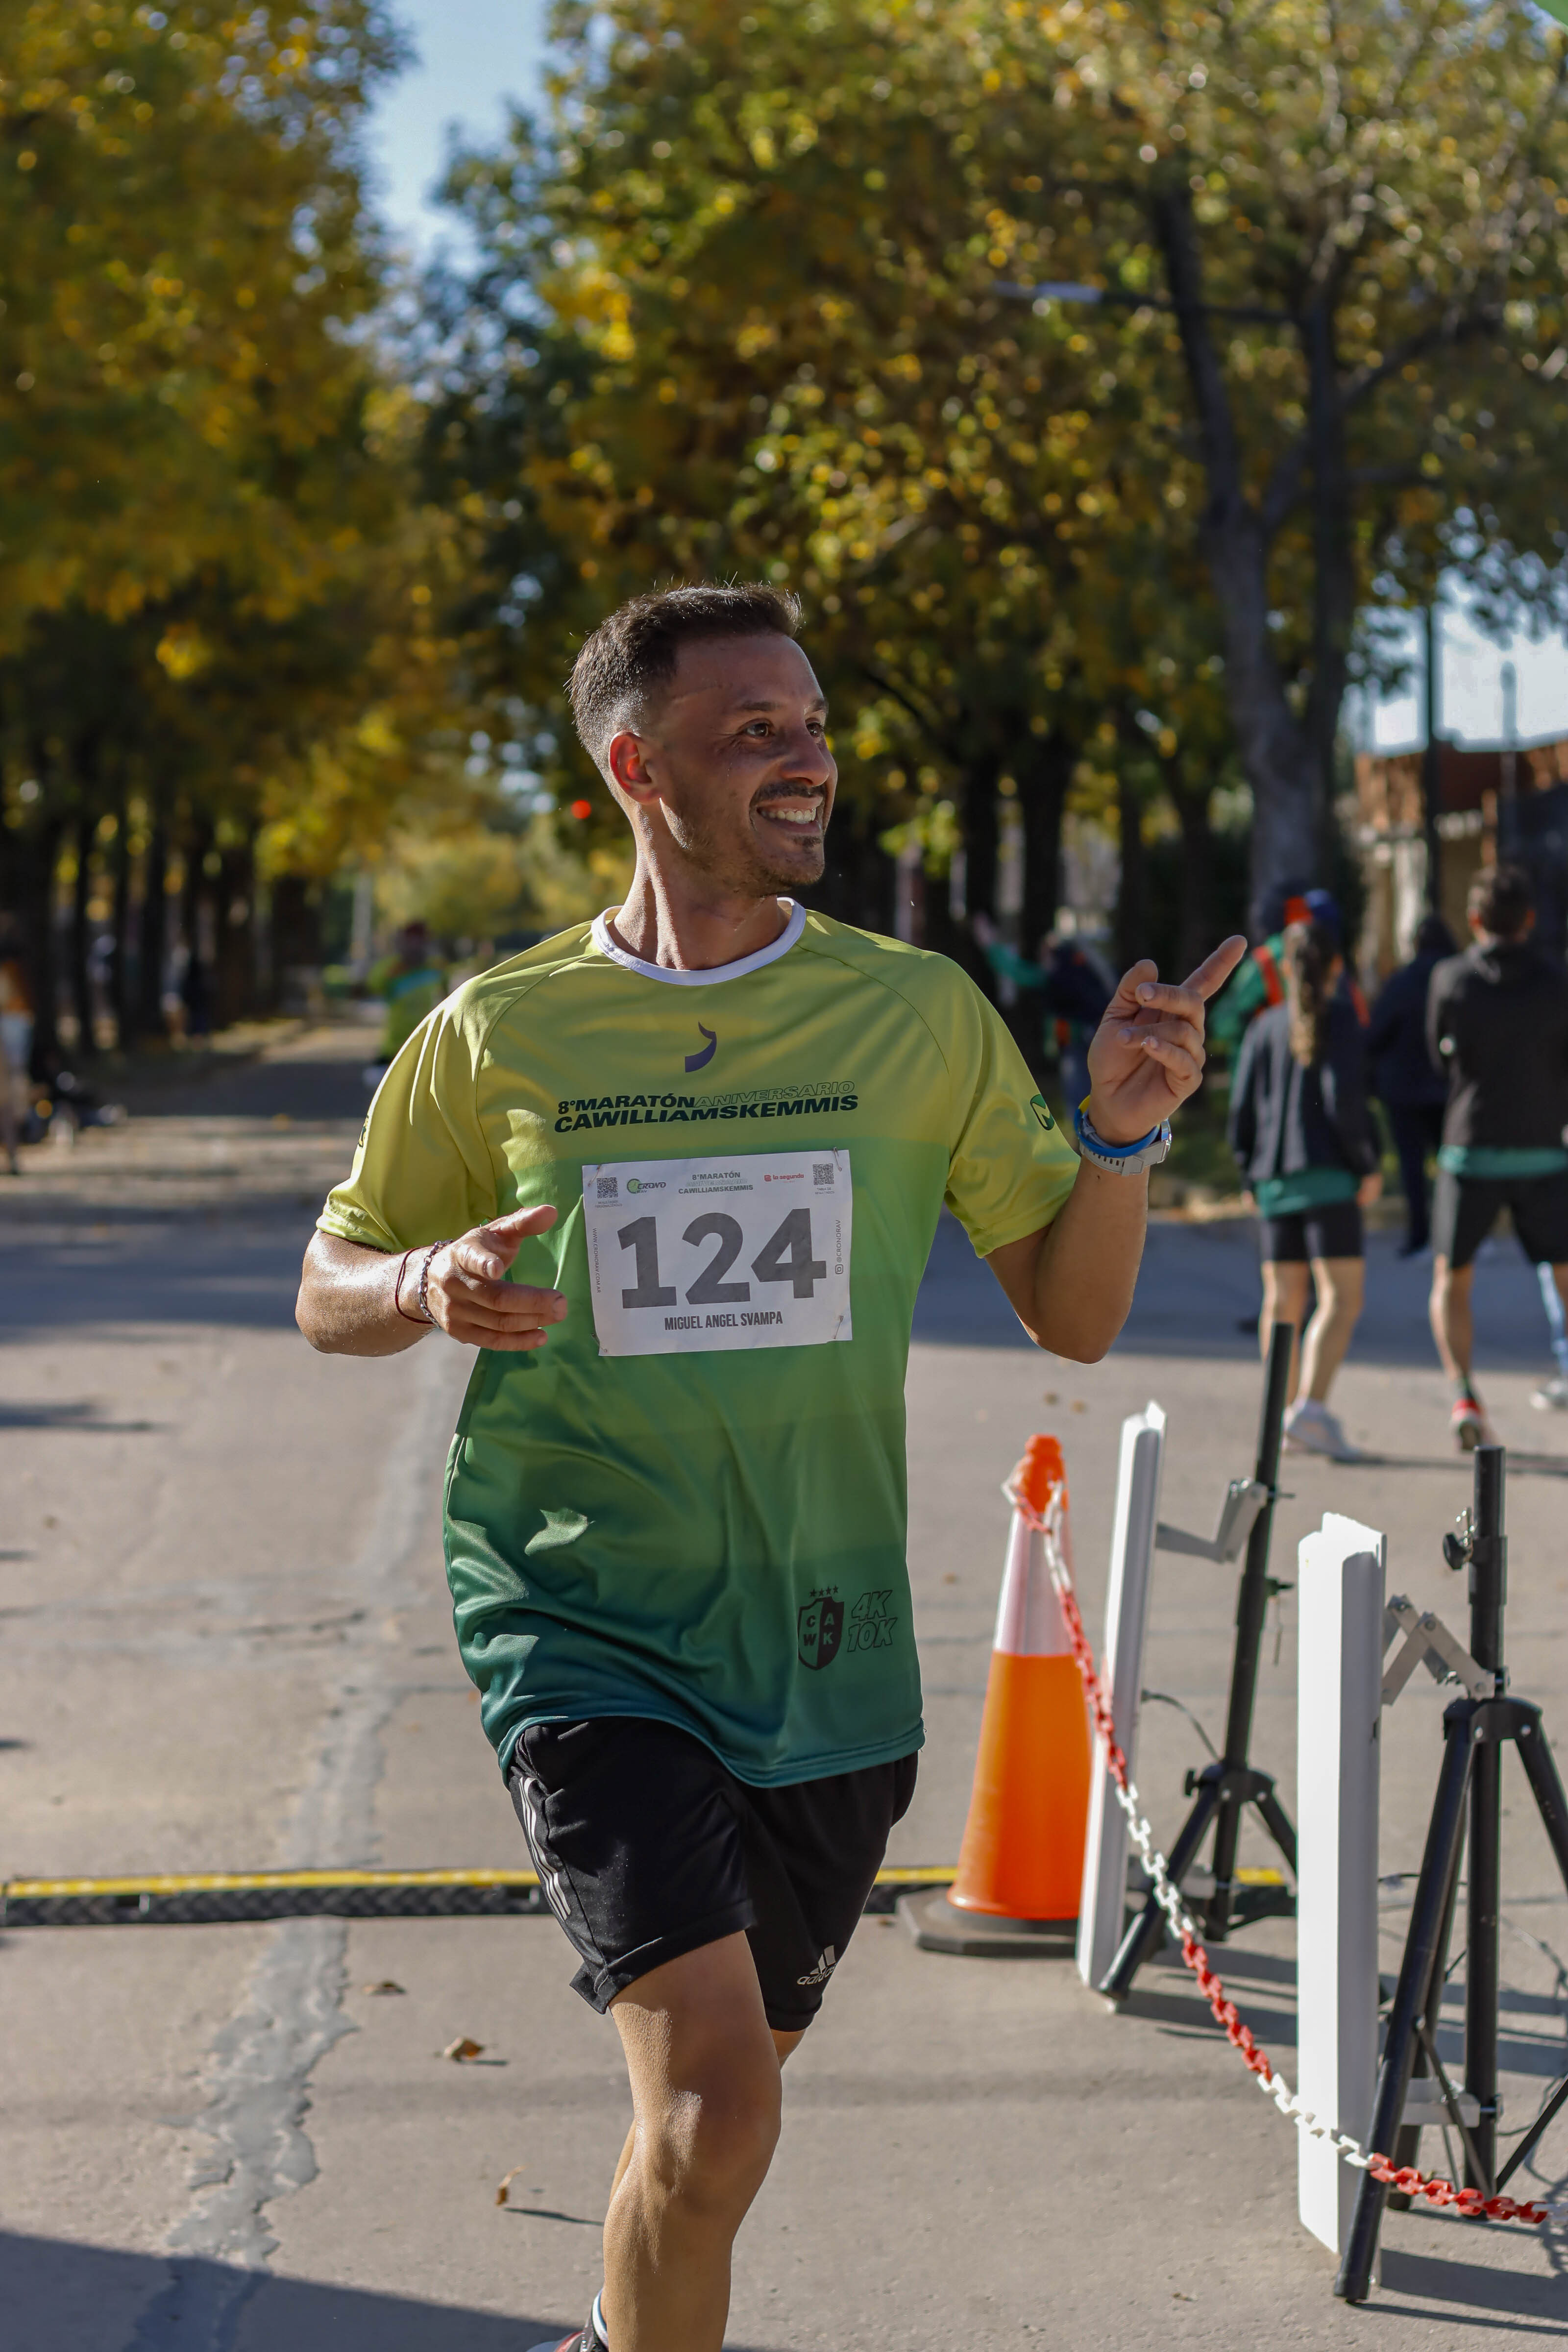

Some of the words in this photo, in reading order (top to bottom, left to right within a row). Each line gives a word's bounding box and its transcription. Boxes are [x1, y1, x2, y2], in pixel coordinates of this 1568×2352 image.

[693, 1081, 855, 1108] ANIVERSARIO
[617, 1207, 827, 1309] 124
[664, 1316, 703, 1330] MIGUEL
[705, 1313, 738, 1328] ANGEL
[740, 1311, 784, 1326] SVAMPA
[851, 1590, 893, 1621] 4K
[847, 1617, 898, 1653] 10K
